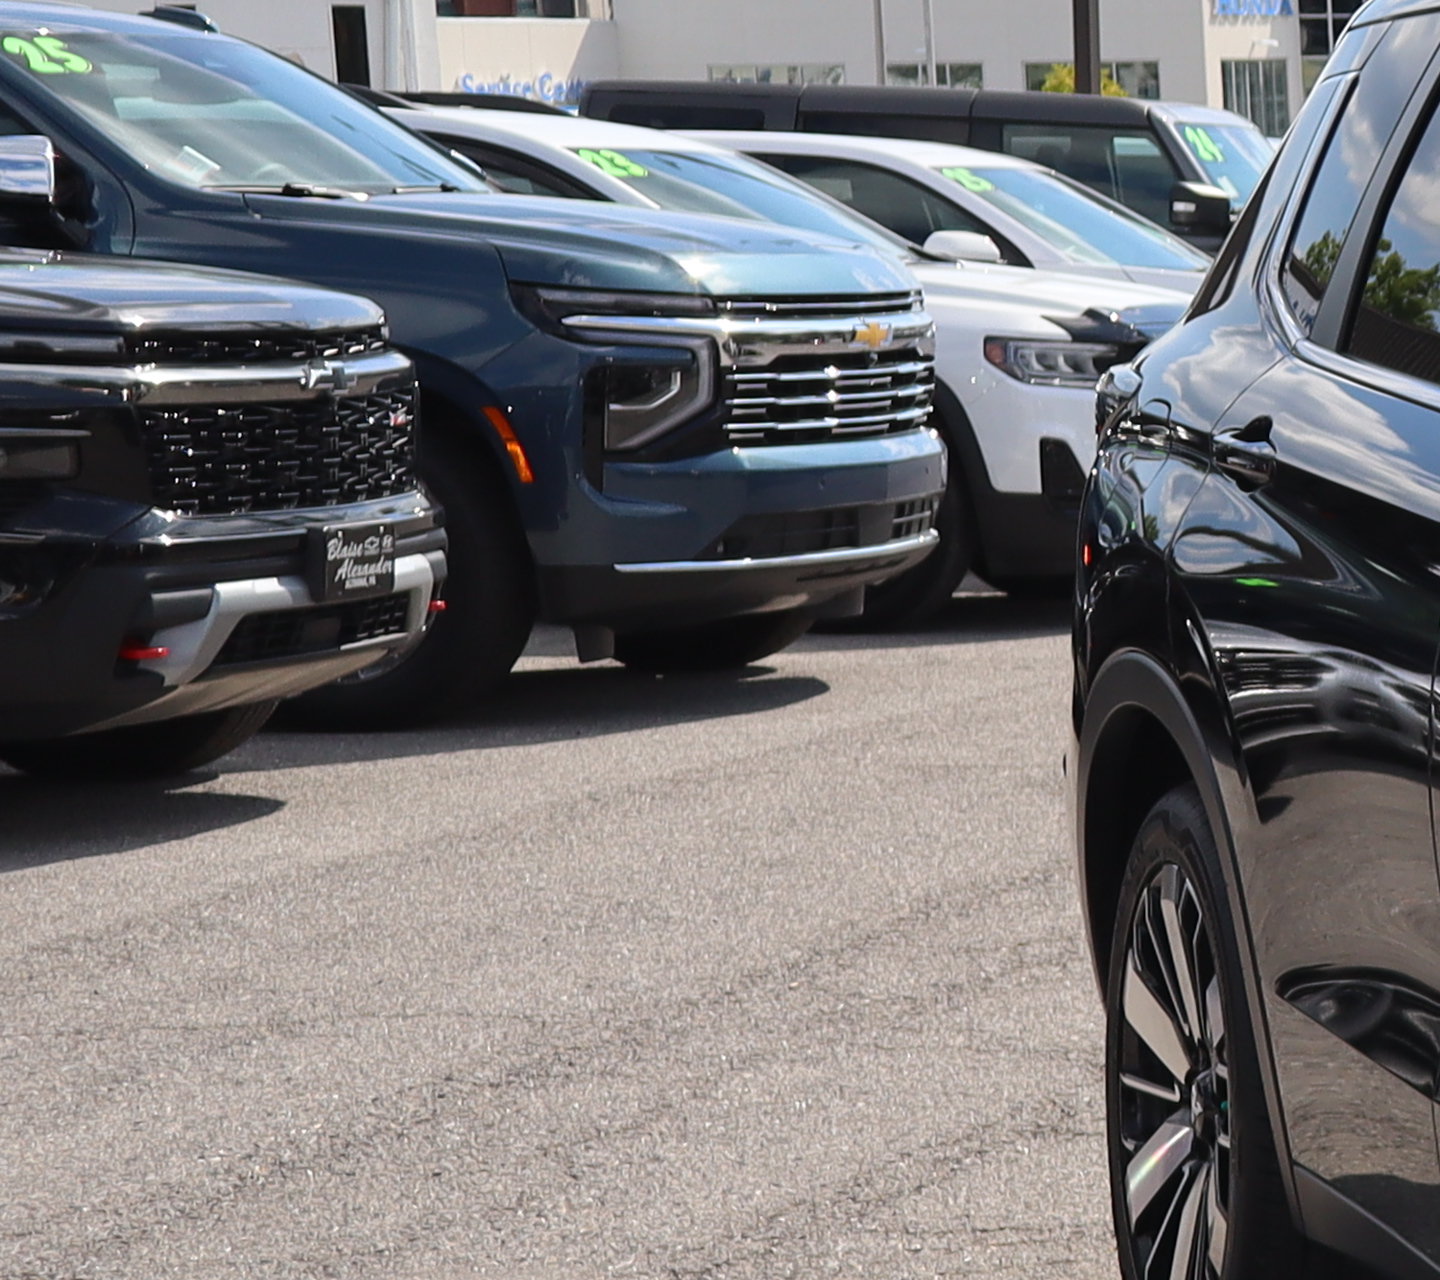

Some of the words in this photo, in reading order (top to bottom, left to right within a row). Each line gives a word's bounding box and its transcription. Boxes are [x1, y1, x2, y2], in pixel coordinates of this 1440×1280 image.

[2, 36, 93, 74] 25
[462, 73, 533, 97] Service
[327, 536, 364, 562] Blaise
[334, 554, 393, 584] Alexander
